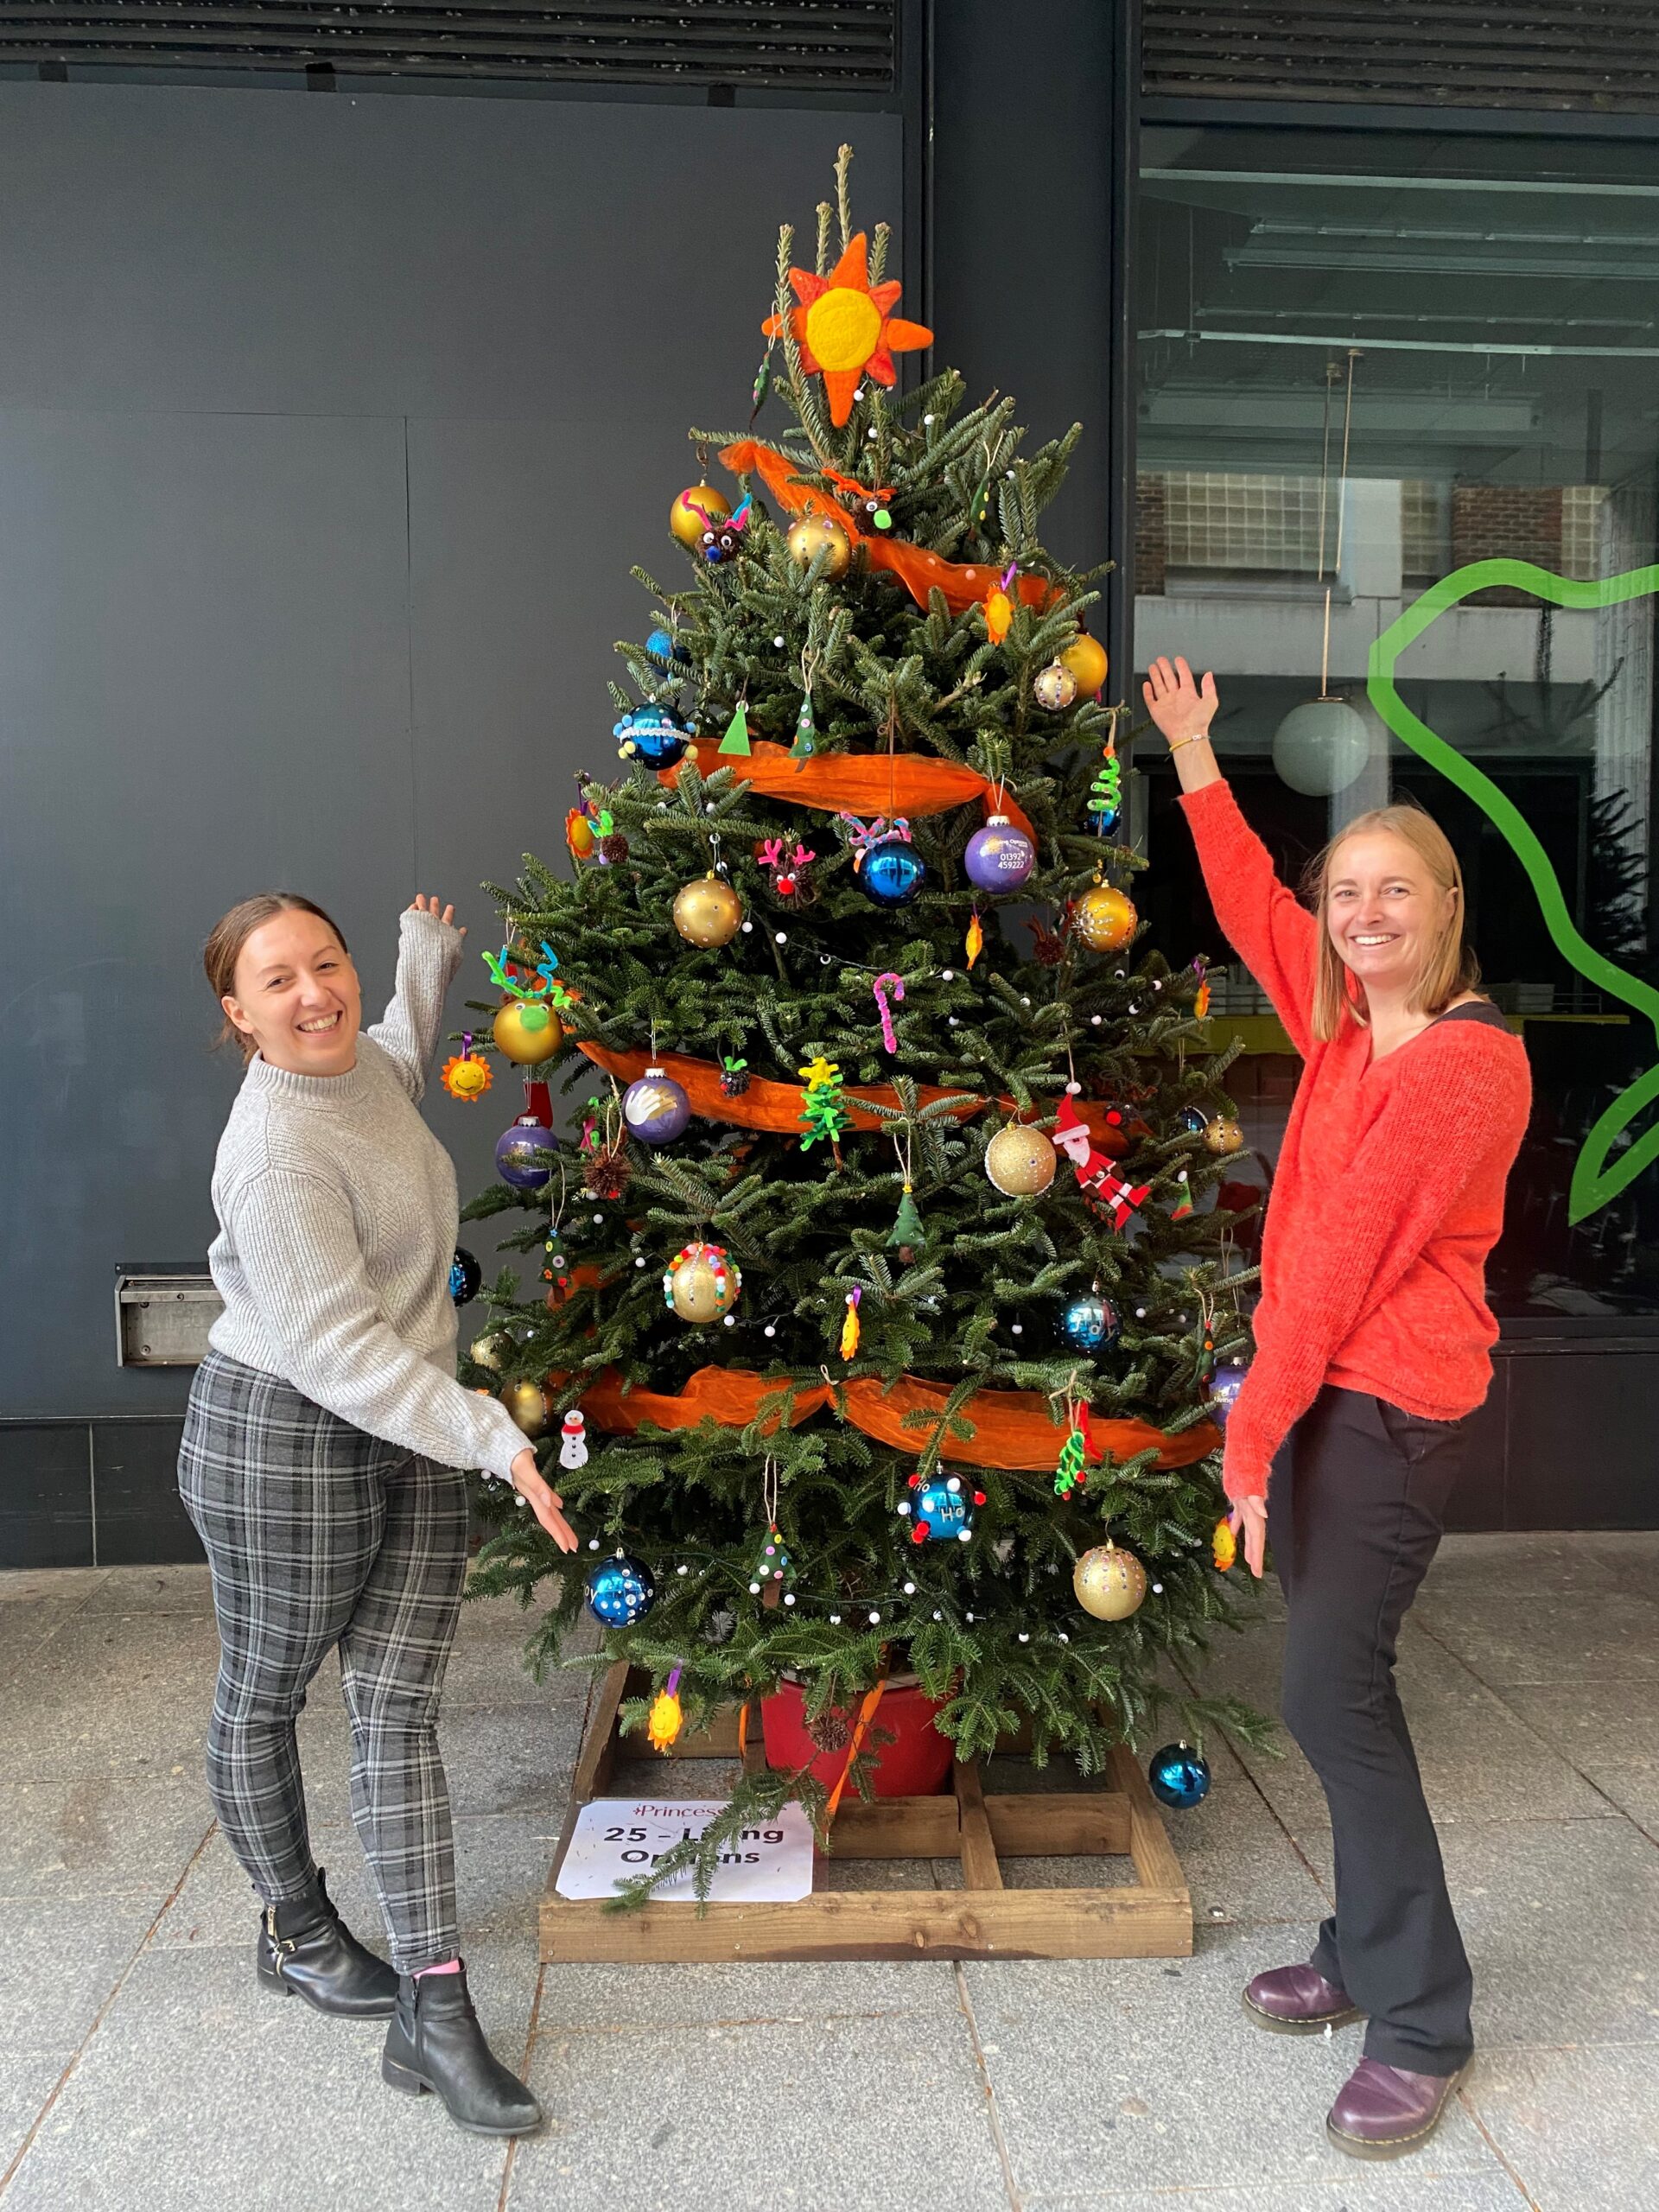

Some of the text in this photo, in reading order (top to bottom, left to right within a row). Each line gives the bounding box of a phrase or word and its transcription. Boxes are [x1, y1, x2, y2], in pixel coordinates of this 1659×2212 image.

[1000, 853, 1021, 861] 01392
[584, 1585, 599, 1605] oy
[640, 1804, 726, 1817] Princess
[603, 1827, 647, 1842] 25
[682, 1827, 785, 1844] Ling
[620, 1850, 760, 1867] Opns
